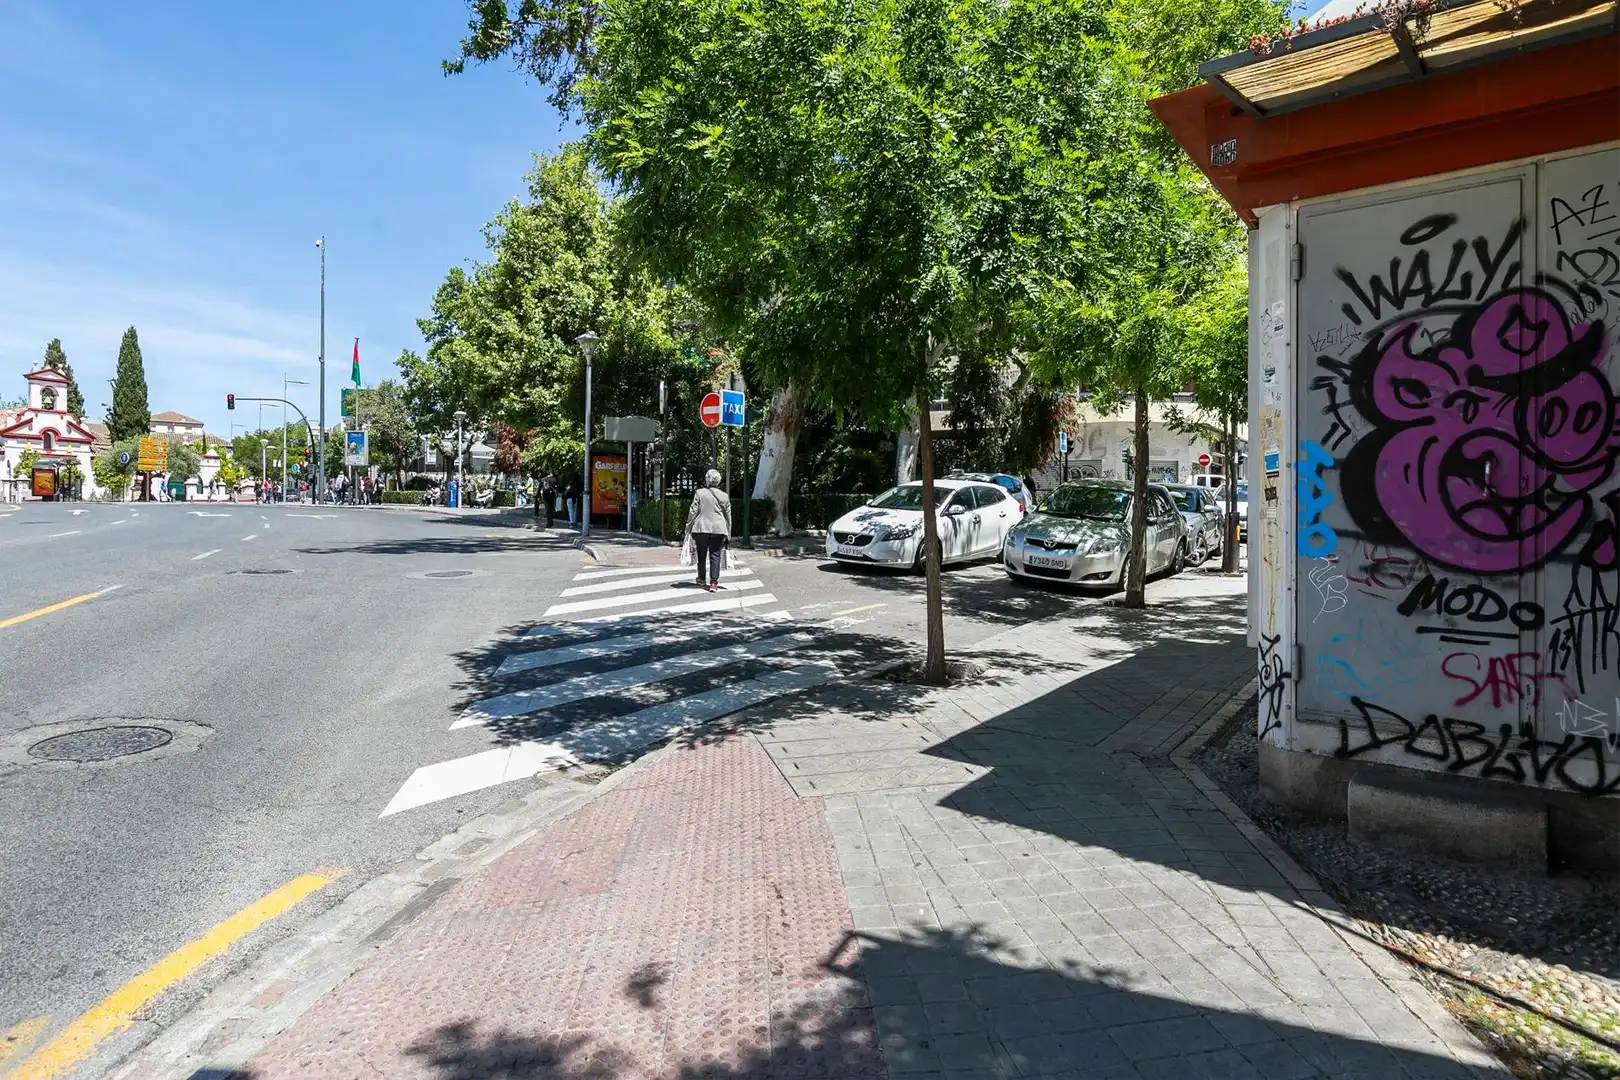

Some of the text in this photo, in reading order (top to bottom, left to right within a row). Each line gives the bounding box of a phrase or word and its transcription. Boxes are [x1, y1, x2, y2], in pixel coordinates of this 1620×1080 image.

[1334, 215, 1528, 321] WALY
[723, 402, 743, 415] TAXI
[595, 461, 627, 470] GARFIELD
[1397, 573, 1545, 631] MODO
